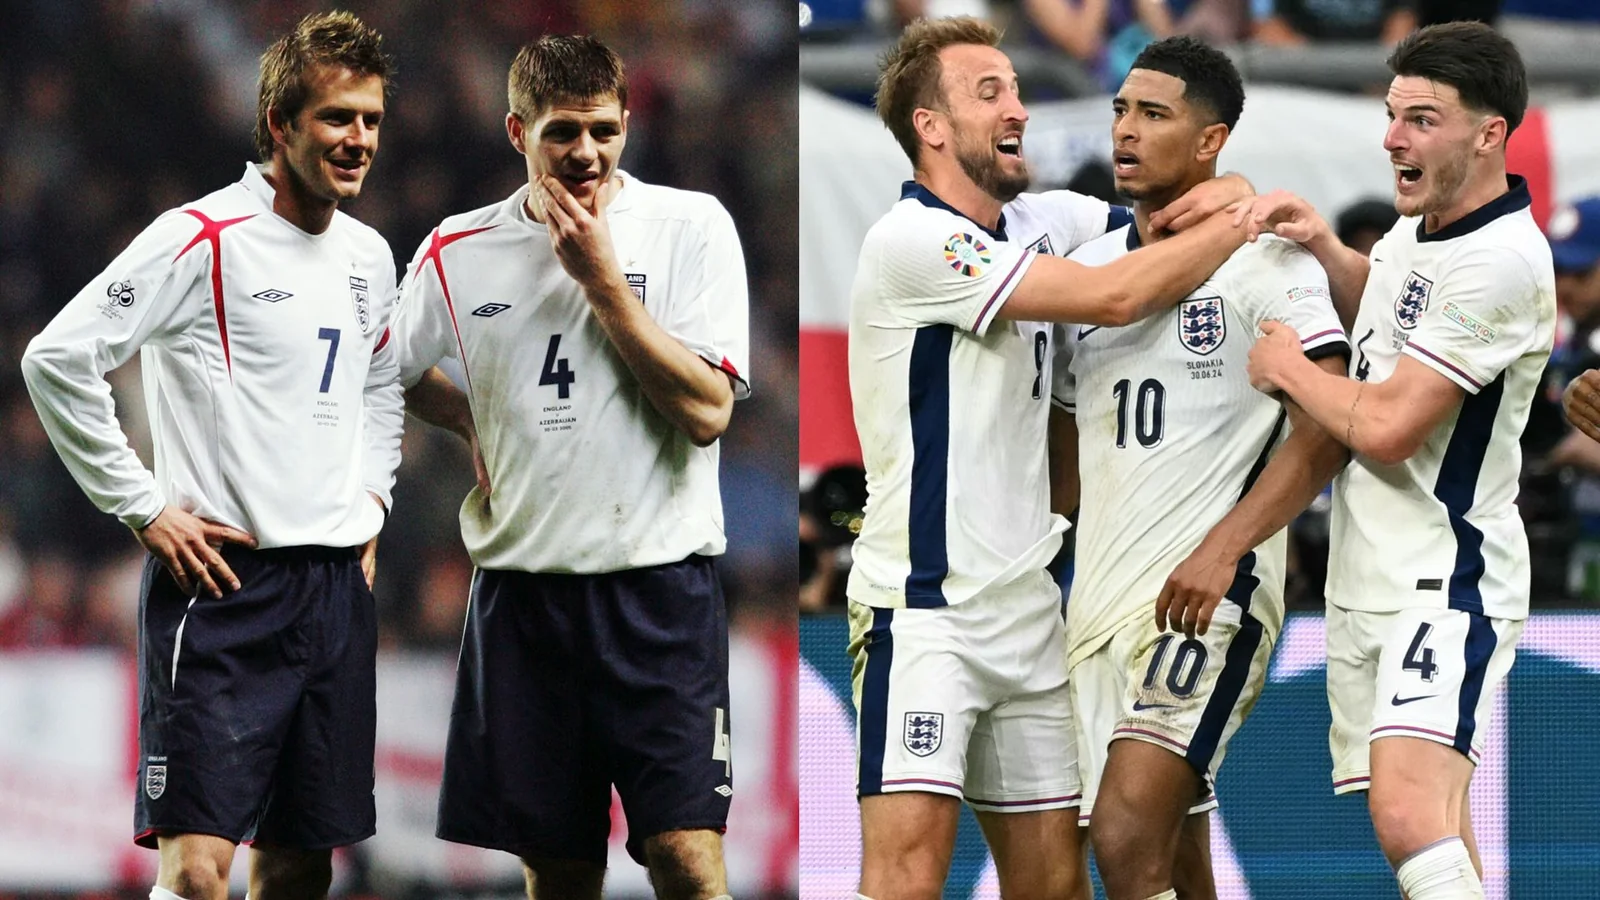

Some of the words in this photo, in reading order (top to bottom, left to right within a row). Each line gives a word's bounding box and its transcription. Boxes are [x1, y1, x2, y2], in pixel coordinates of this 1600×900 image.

[1443, 305, 1496, 340] FOUNDATION
[317, 327, 341, 394] 7
[538, 333, 575, 399] 4
[1032, 330, 1048, 400] 9
[1186, 358, 1224, 370] SLOVAKIA
[1190, 369, 1222, 380] 30.06.24
[543, 404, 572, 413] ENGLAND
[1113, 378, 1167, 449] 10
[1143, 632, 1209, 700] 10
[1402, 621, 1439, 683] 4
[712, 707, 730, 778] 4
